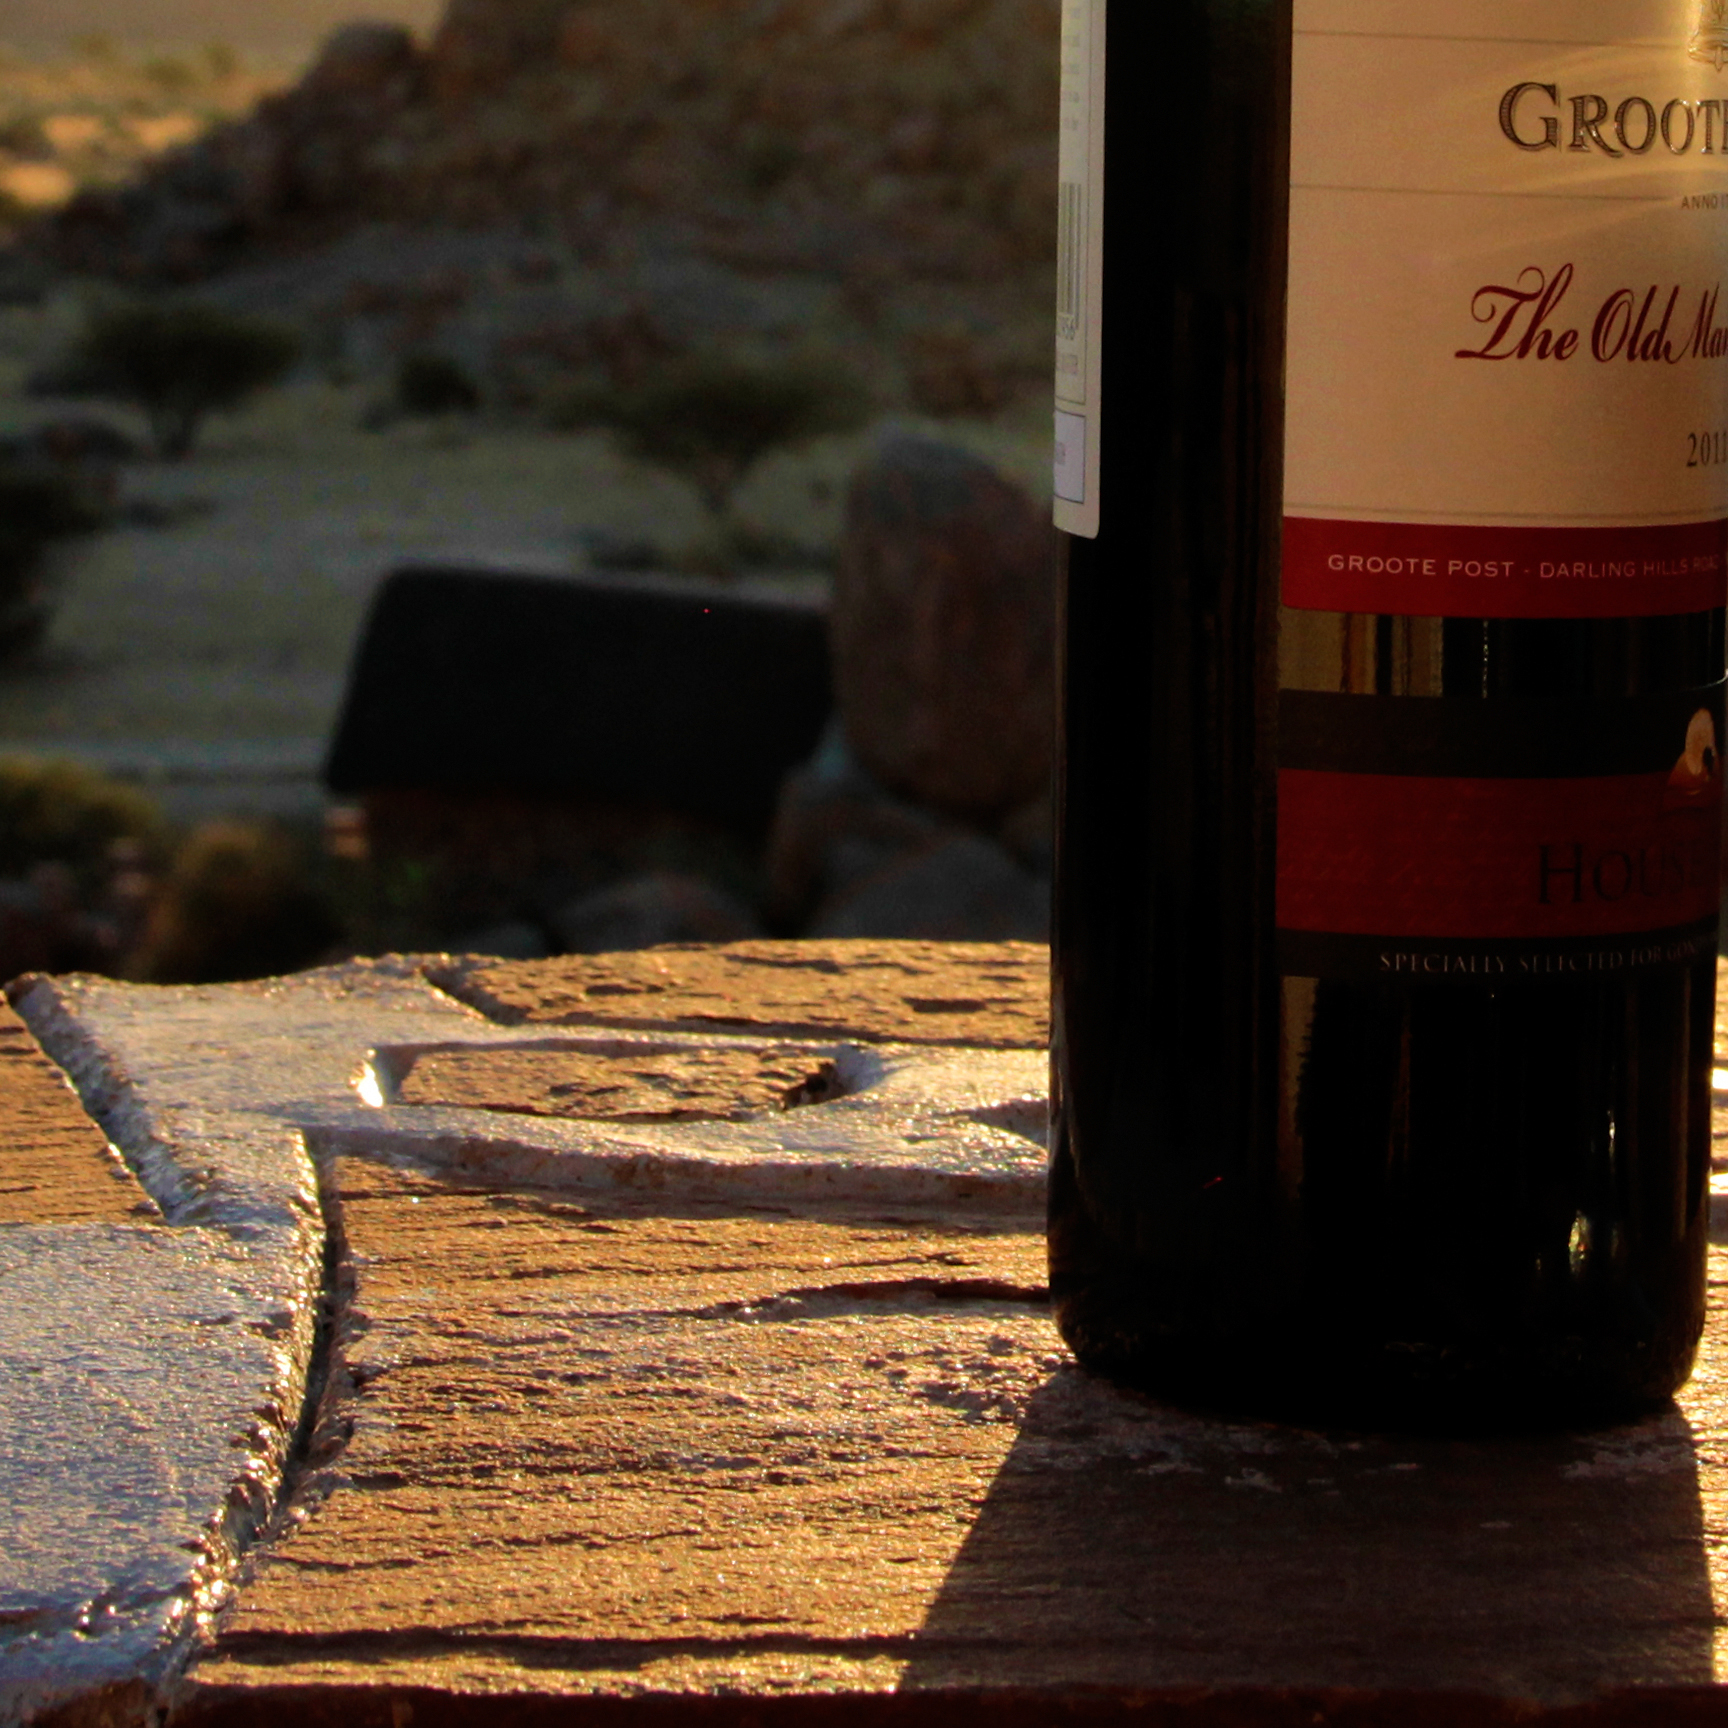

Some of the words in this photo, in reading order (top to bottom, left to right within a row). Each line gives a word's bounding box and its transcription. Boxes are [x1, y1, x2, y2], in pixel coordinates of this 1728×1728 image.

[1681, 194, 1718, 210] ANNO
[1455, 263, 1578, 363] The
[1591, 284, 1679, 364] Old
[1327, 553, 1437, 577] GROOTE
[1447, 558, 1515, 578] POST
[1539, 560, 1636, 580] DARLING
[1643, 558, 1688, 576] HILLS
[1379, 951, 1506, 974] SPECIALLY
[1518, 950, 1624, 974] SELECTED
[1630, 945, 1662, 967] FOR
